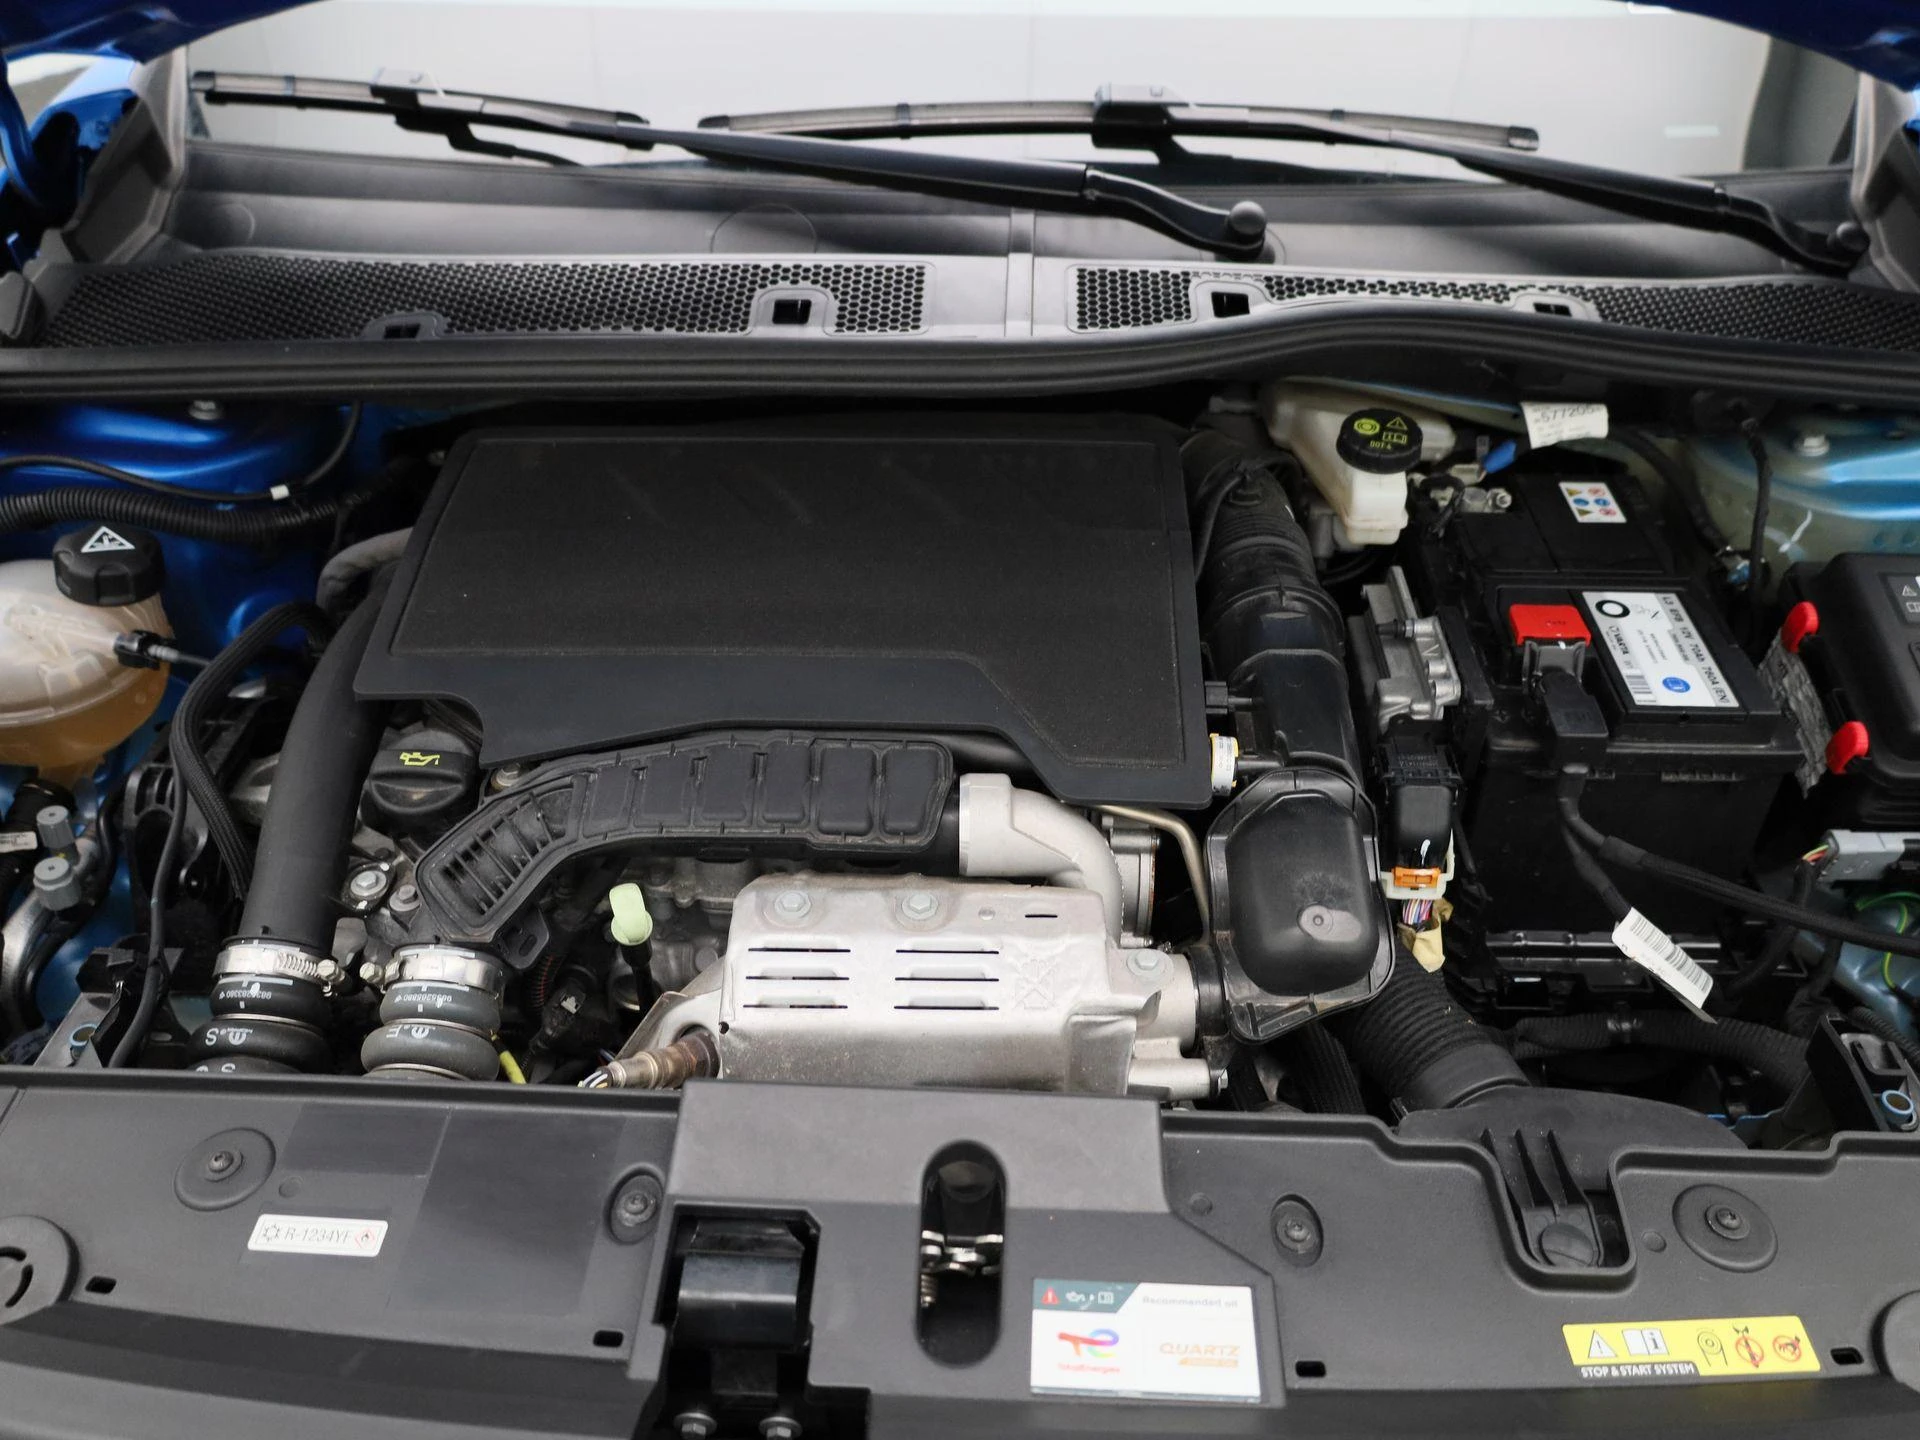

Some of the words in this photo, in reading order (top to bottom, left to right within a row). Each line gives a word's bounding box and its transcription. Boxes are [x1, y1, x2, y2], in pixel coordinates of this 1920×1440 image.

[1159, 1342, 1240, 1357] QUARTZ
[1581, 1366, 1609, 1378] STOP
[1611, 1366, 1620, 1377] &
[1620, 1364, 1652, 1376] START
[1654, 1363, 1695, 1375] SYSTEM
